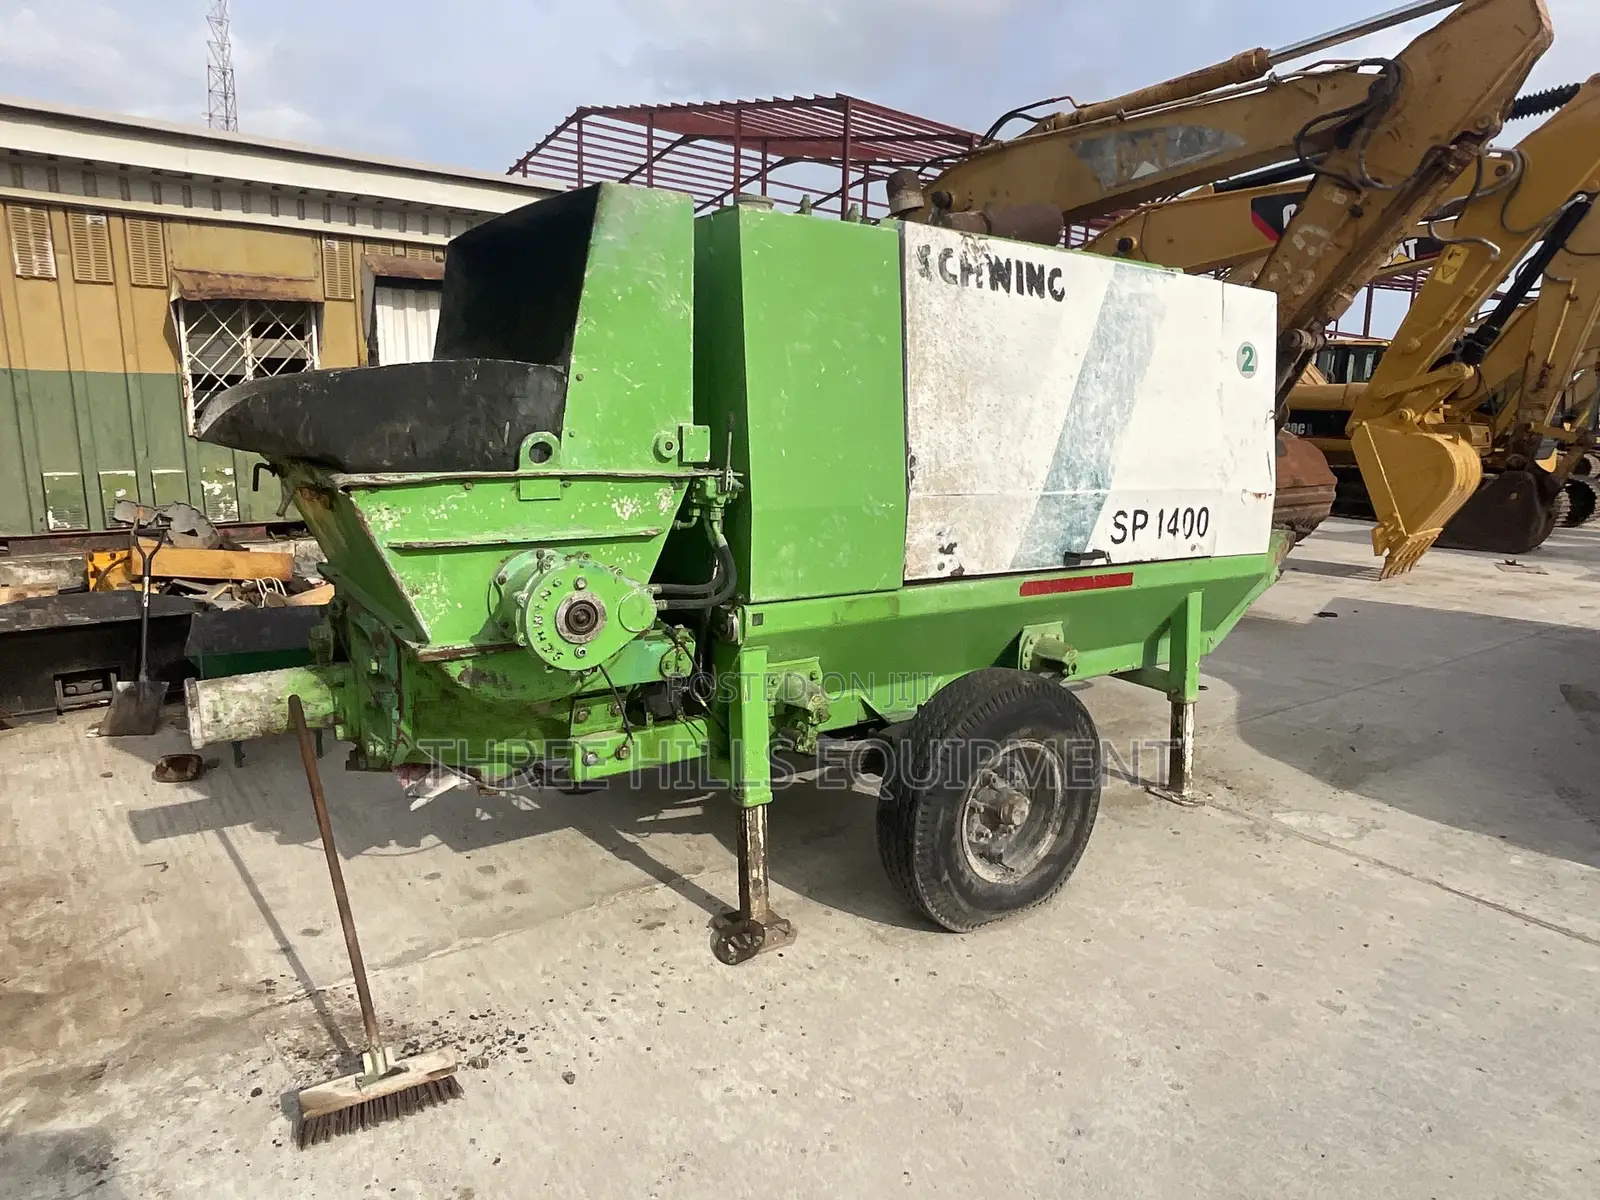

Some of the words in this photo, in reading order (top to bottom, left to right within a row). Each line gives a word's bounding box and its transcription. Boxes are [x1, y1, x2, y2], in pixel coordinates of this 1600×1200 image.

[1380, 238, 1418, 267] AT
[1241, 346, 1254, 372] 2
[1110, 509, 1149, 545] SP
[1158, 506, 1209, 540] 1400
